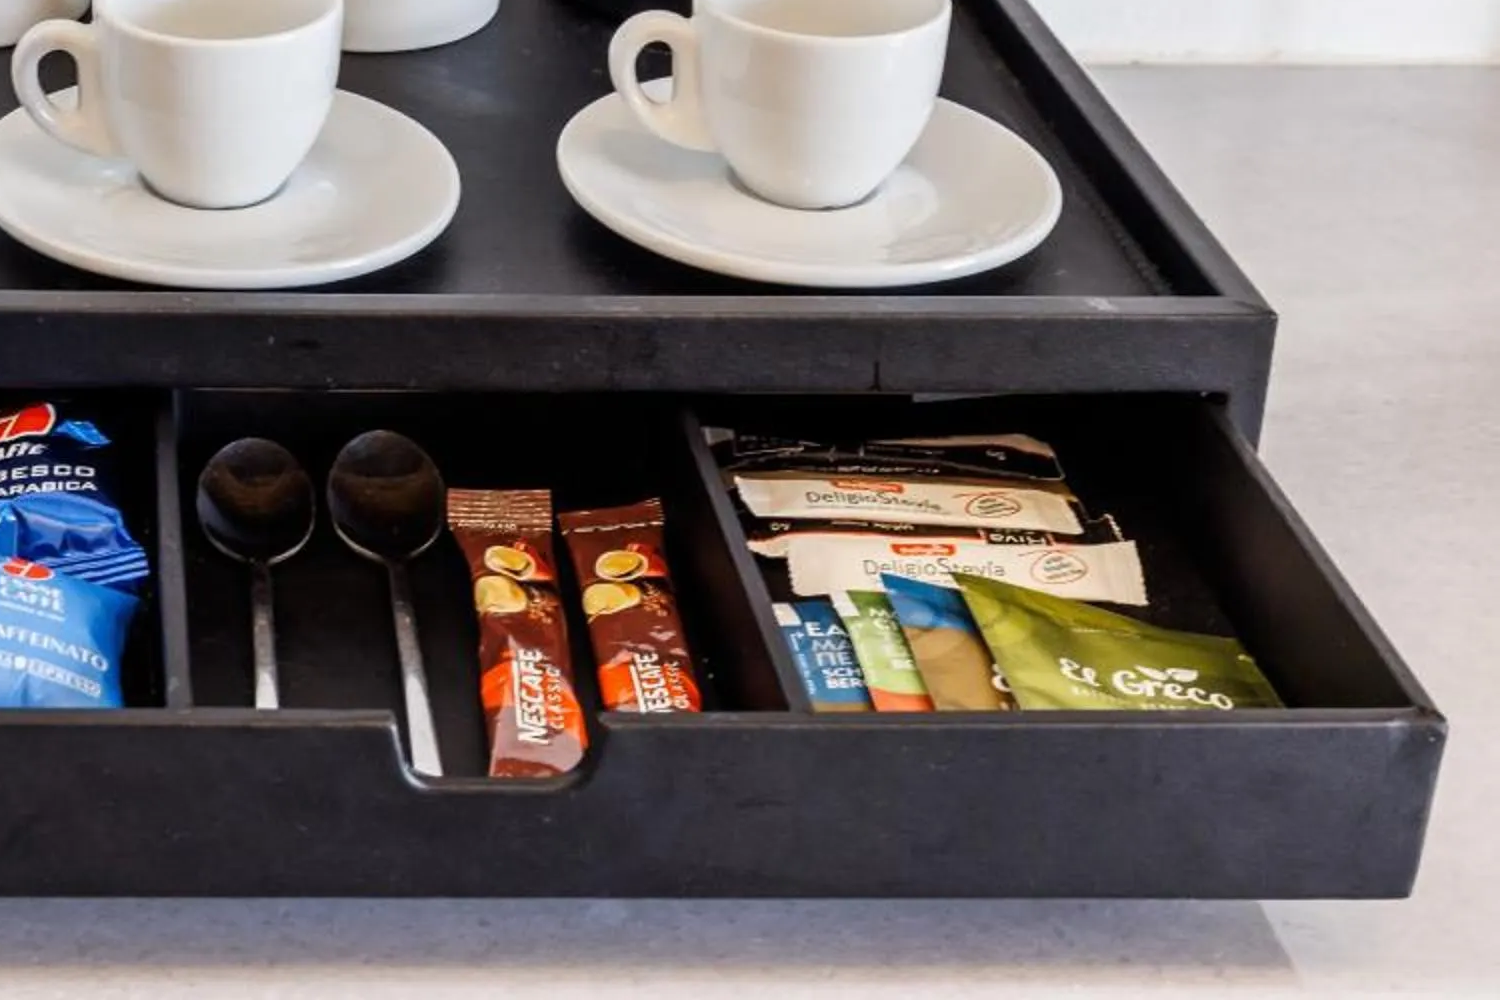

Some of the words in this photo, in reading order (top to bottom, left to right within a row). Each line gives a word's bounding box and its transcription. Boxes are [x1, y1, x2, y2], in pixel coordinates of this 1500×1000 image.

[804, 621, 846, 637] EA
[822, 668, 860, 677] SCH
[826, 678, 864, 689] BER
[1111, 669, 1234, 710] Greco
